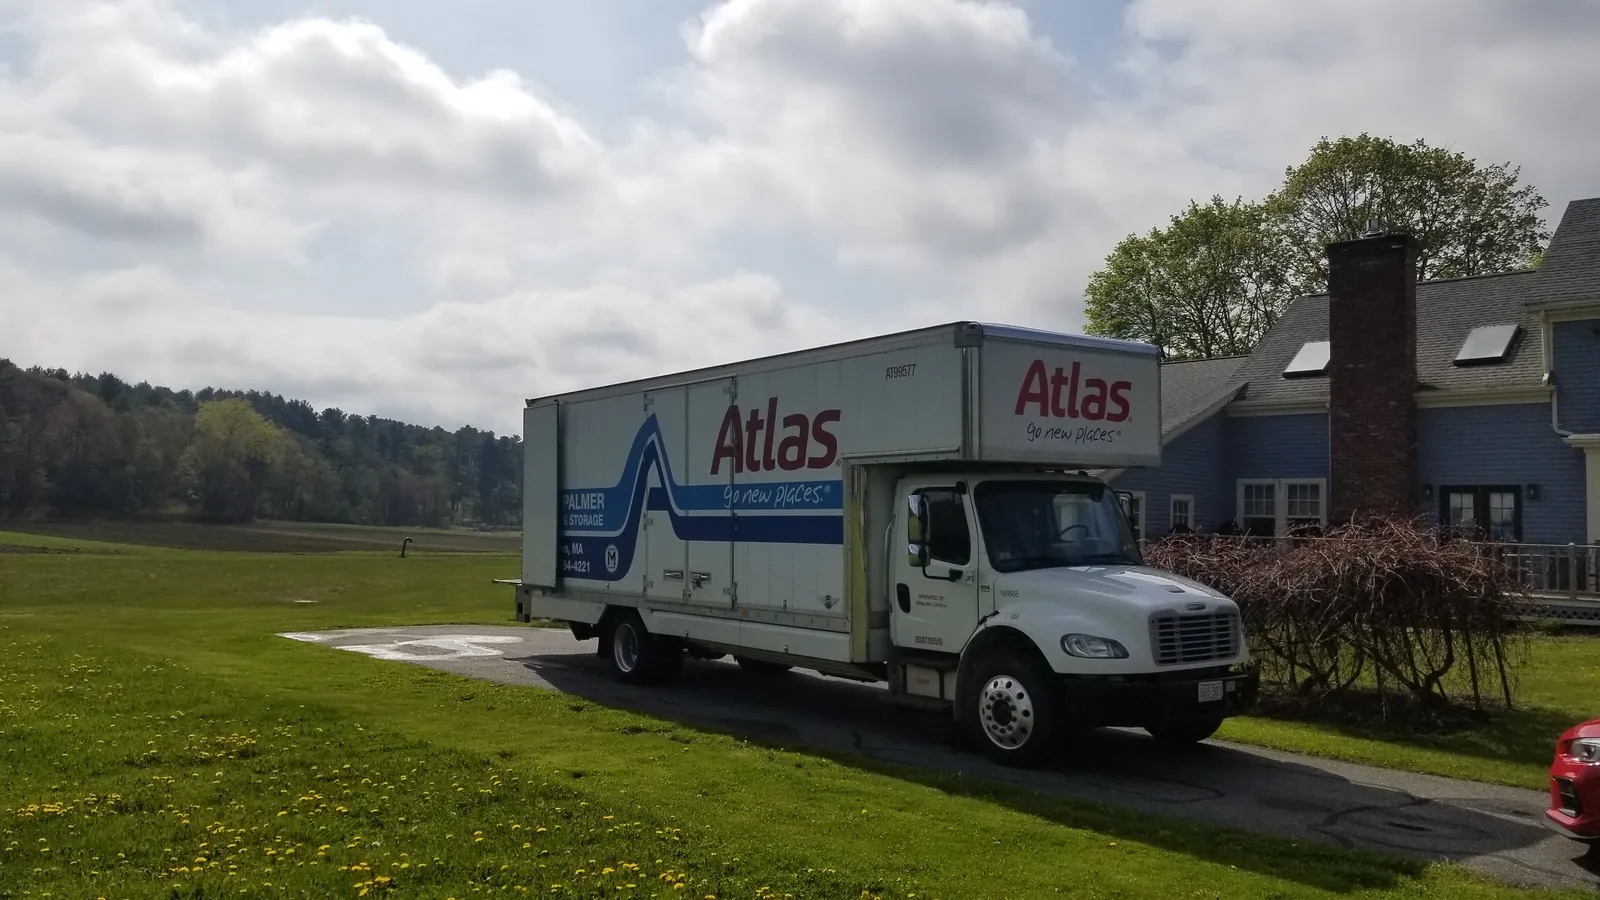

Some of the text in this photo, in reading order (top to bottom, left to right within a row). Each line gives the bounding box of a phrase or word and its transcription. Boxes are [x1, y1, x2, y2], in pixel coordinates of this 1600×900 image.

[885, 363, 916, 380] AT99577
[1015, 359, 1132, 423] Atlas
[710, 396, 841, 475] Atlas
[1026, 422, 1042, 442] go
[1044, 426, 1073, 440] new
[563, 493, 605, 510] PALMER
[723, 485, 740, 509] go
[742, 488, 772, 503] new
[569, 514, 604, 526] STORAGE
[572, 543, 584, 555] MA
